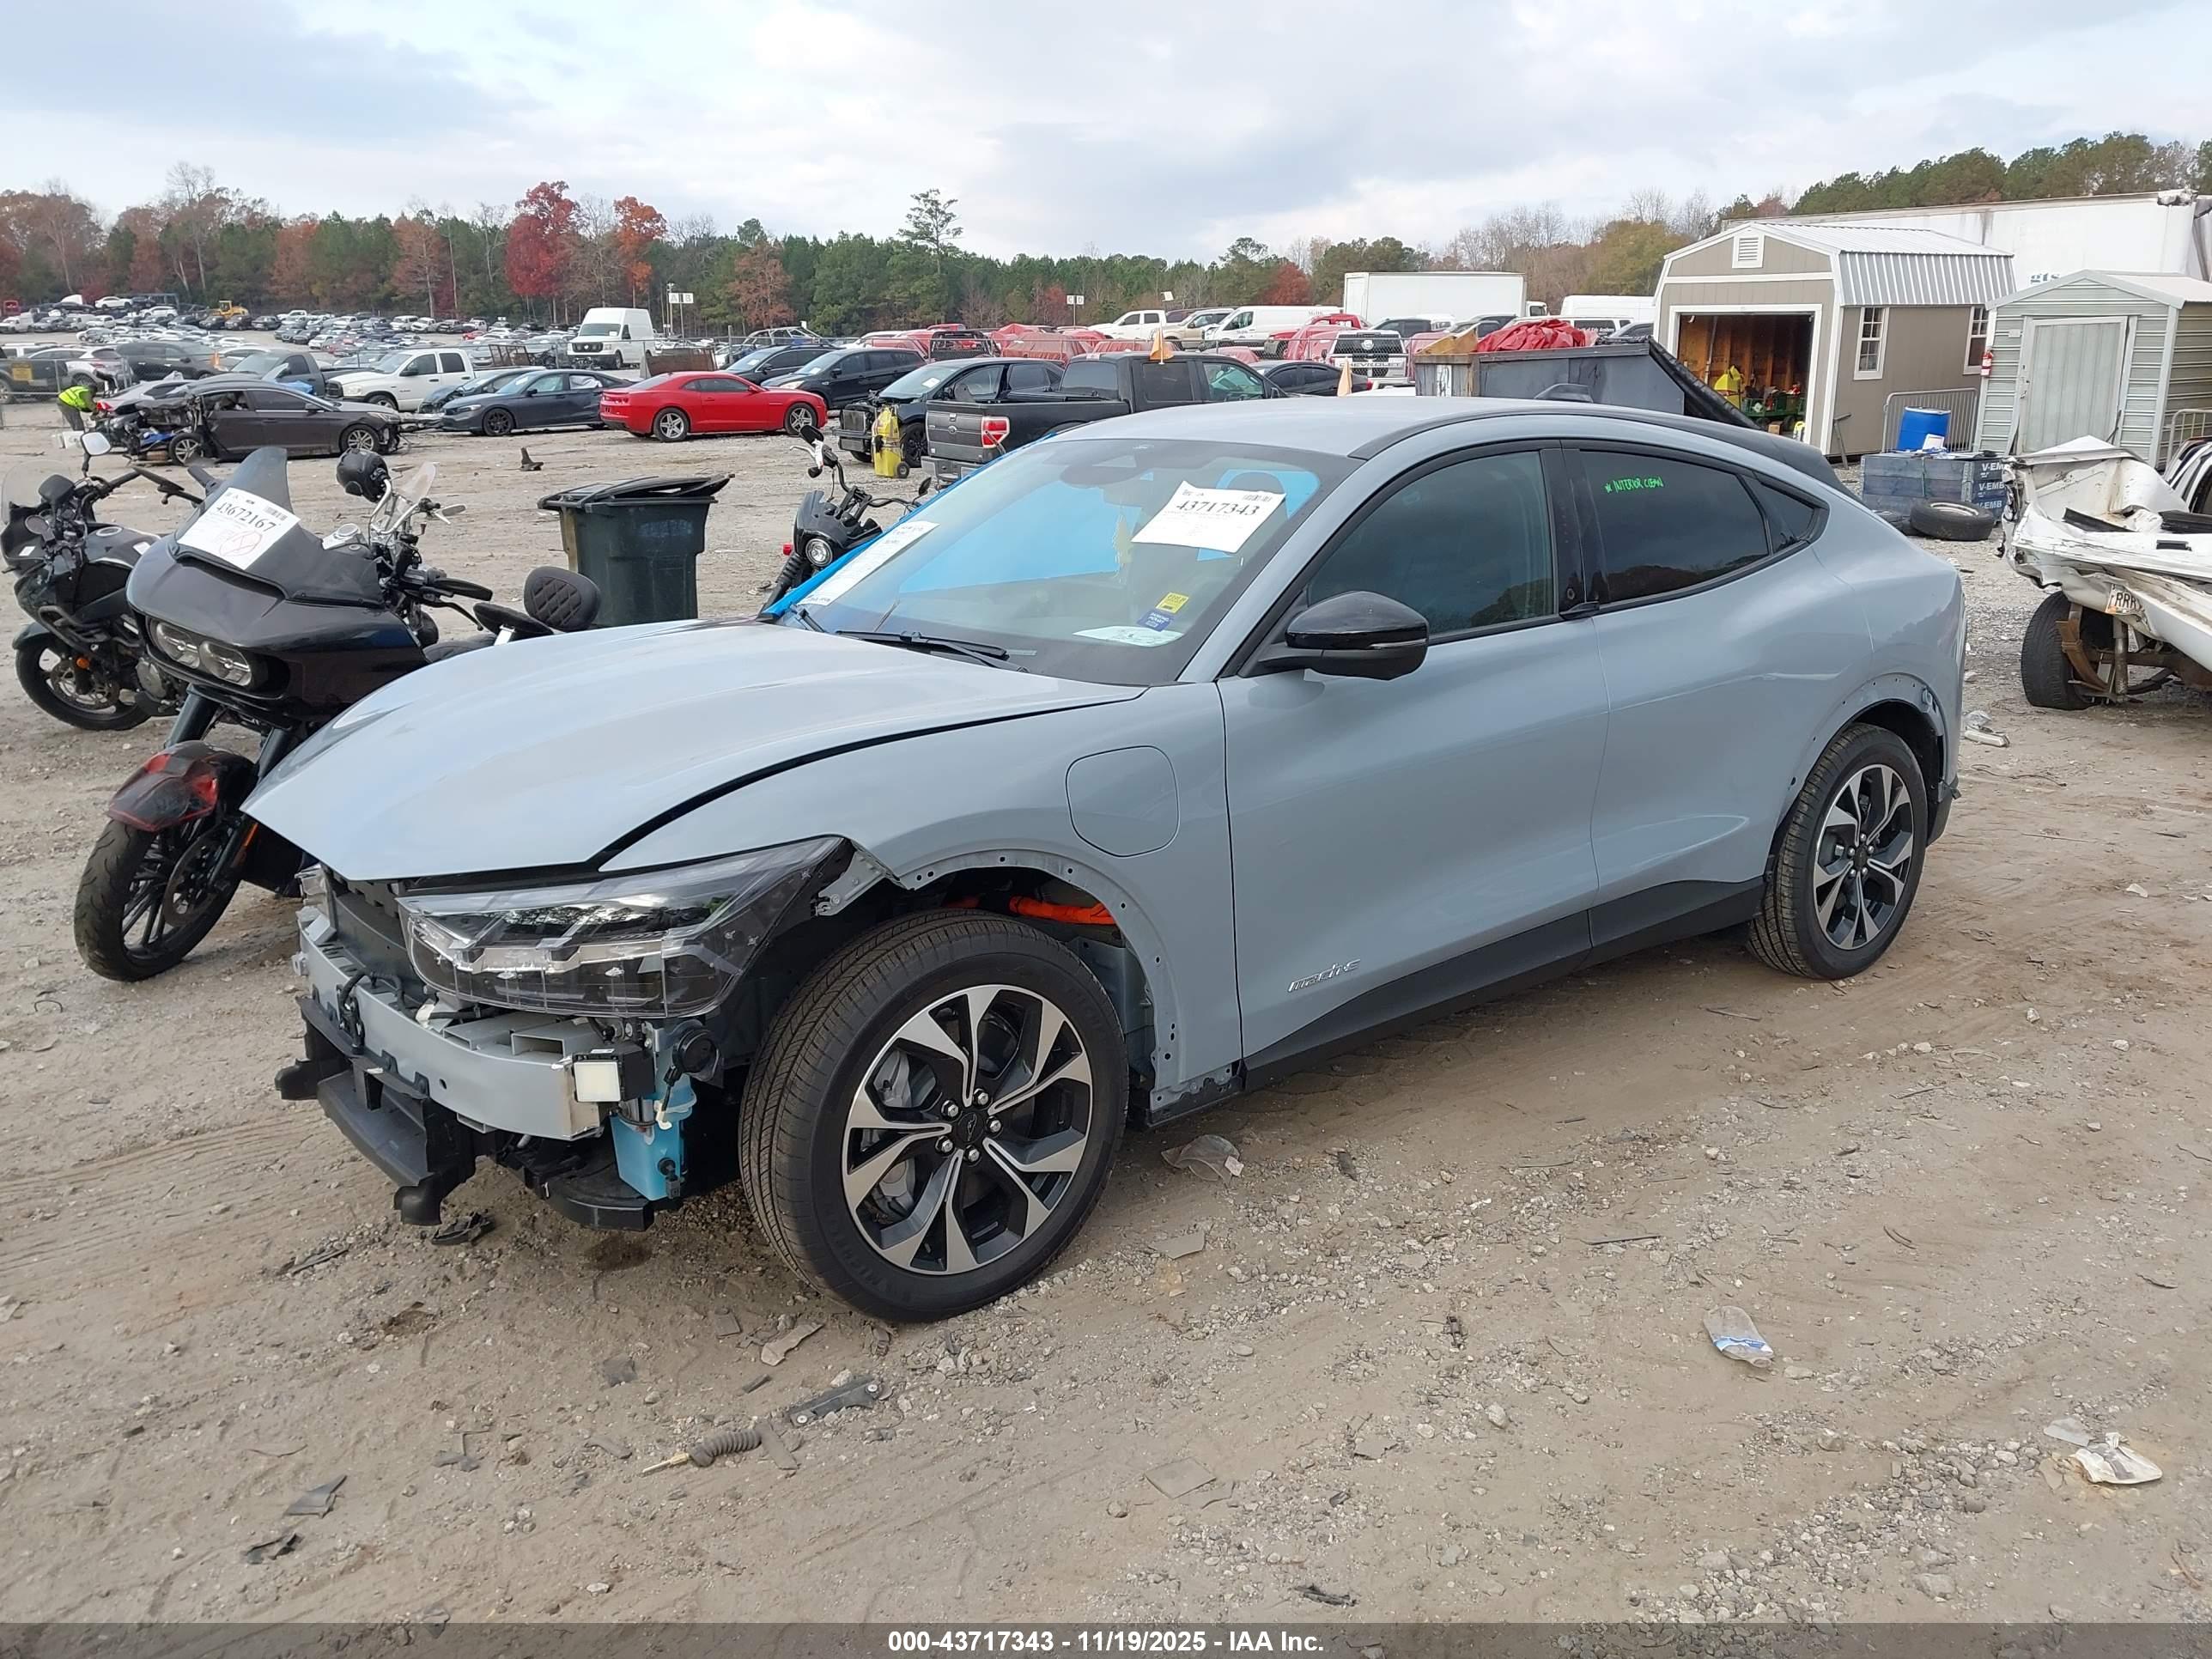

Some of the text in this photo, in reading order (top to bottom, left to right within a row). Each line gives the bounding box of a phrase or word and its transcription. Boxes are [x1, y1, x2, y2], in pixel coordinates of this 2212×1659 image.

[1978, 481, 2005, 490] V-EMB
[1176, 500, 1261, 516] 43717343
[216, 501, 276, 532] 43672167
